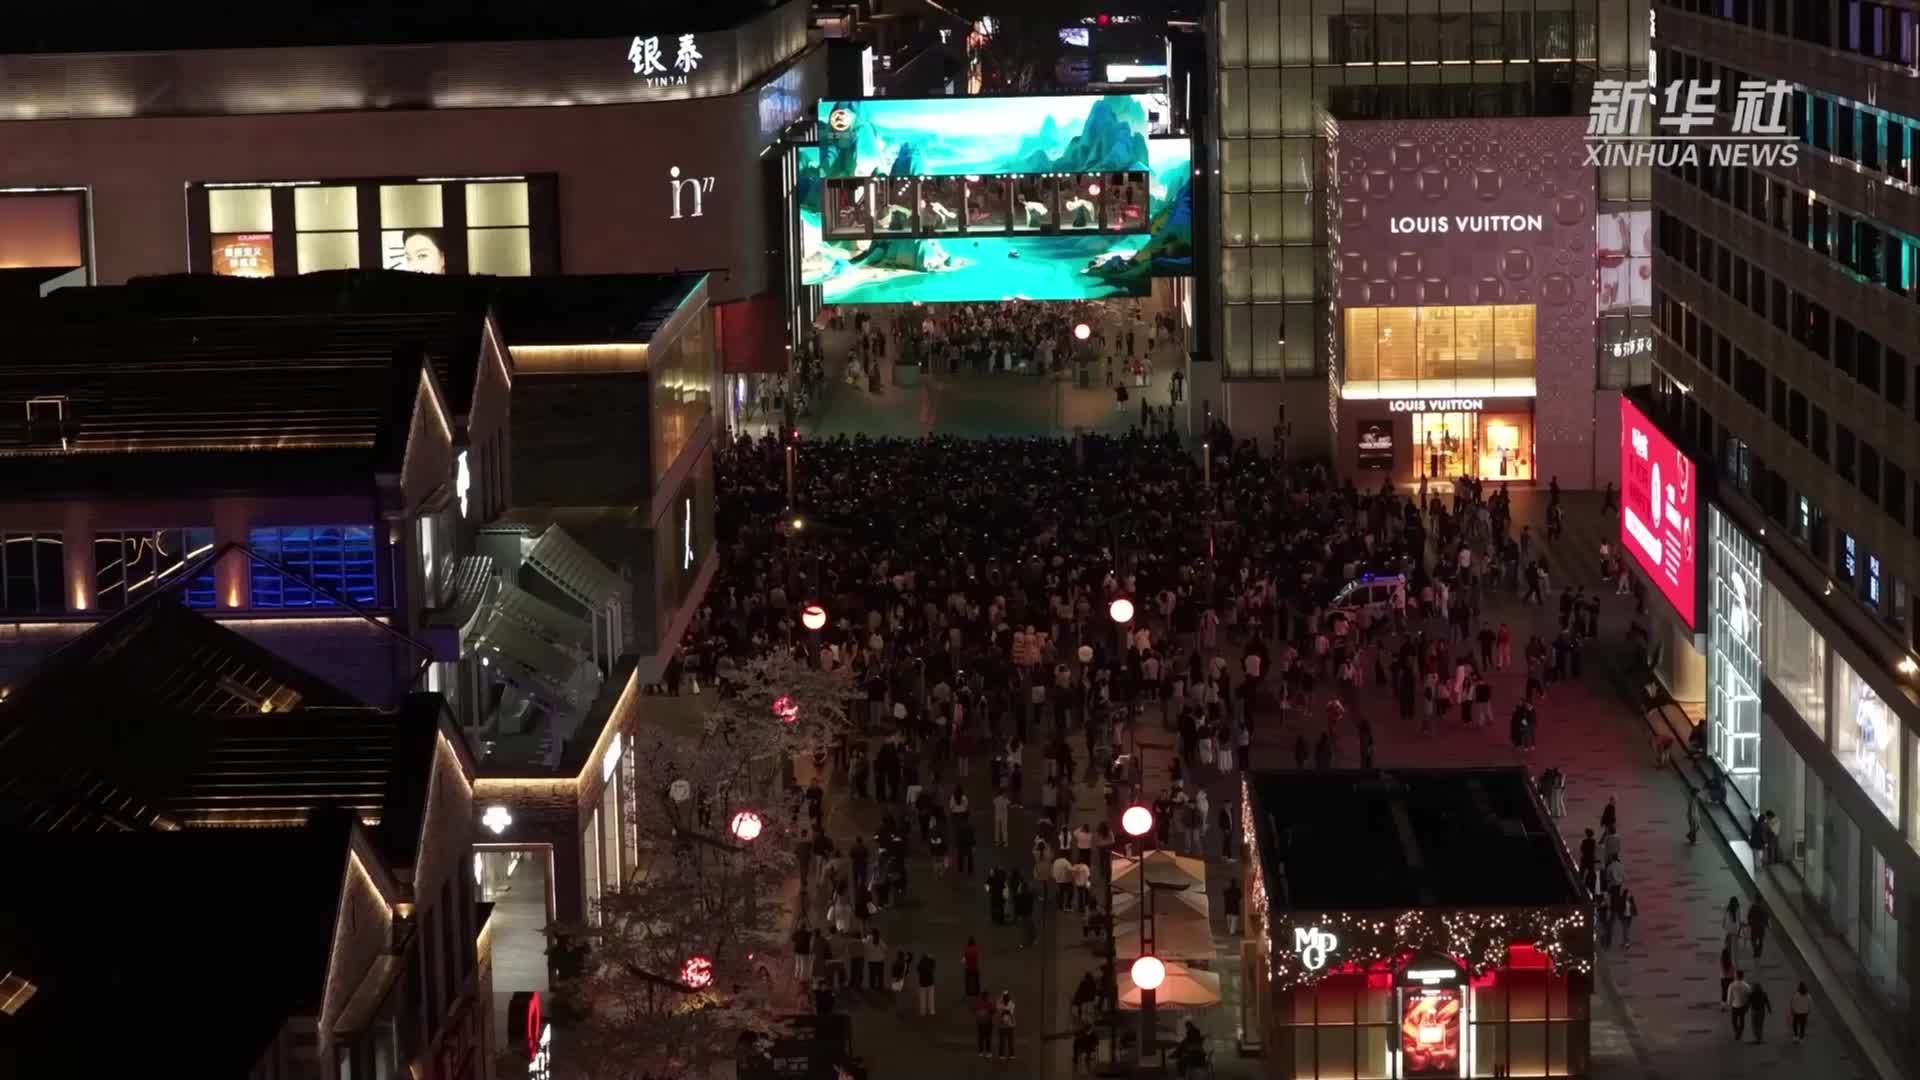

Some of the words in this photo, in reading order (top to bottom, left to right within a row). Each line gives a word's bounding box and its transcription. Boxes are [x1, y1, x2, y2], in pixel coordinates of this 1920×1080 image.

[627, 33, 703, 76] 银泰
[1390, 215, 1449, 234] LOUIS
[1455, 214, 1543, 233] VUITTON
[1389, 399, 1426, 412] LOUIS
[1428, 399, 1483, 411] VUITTON
